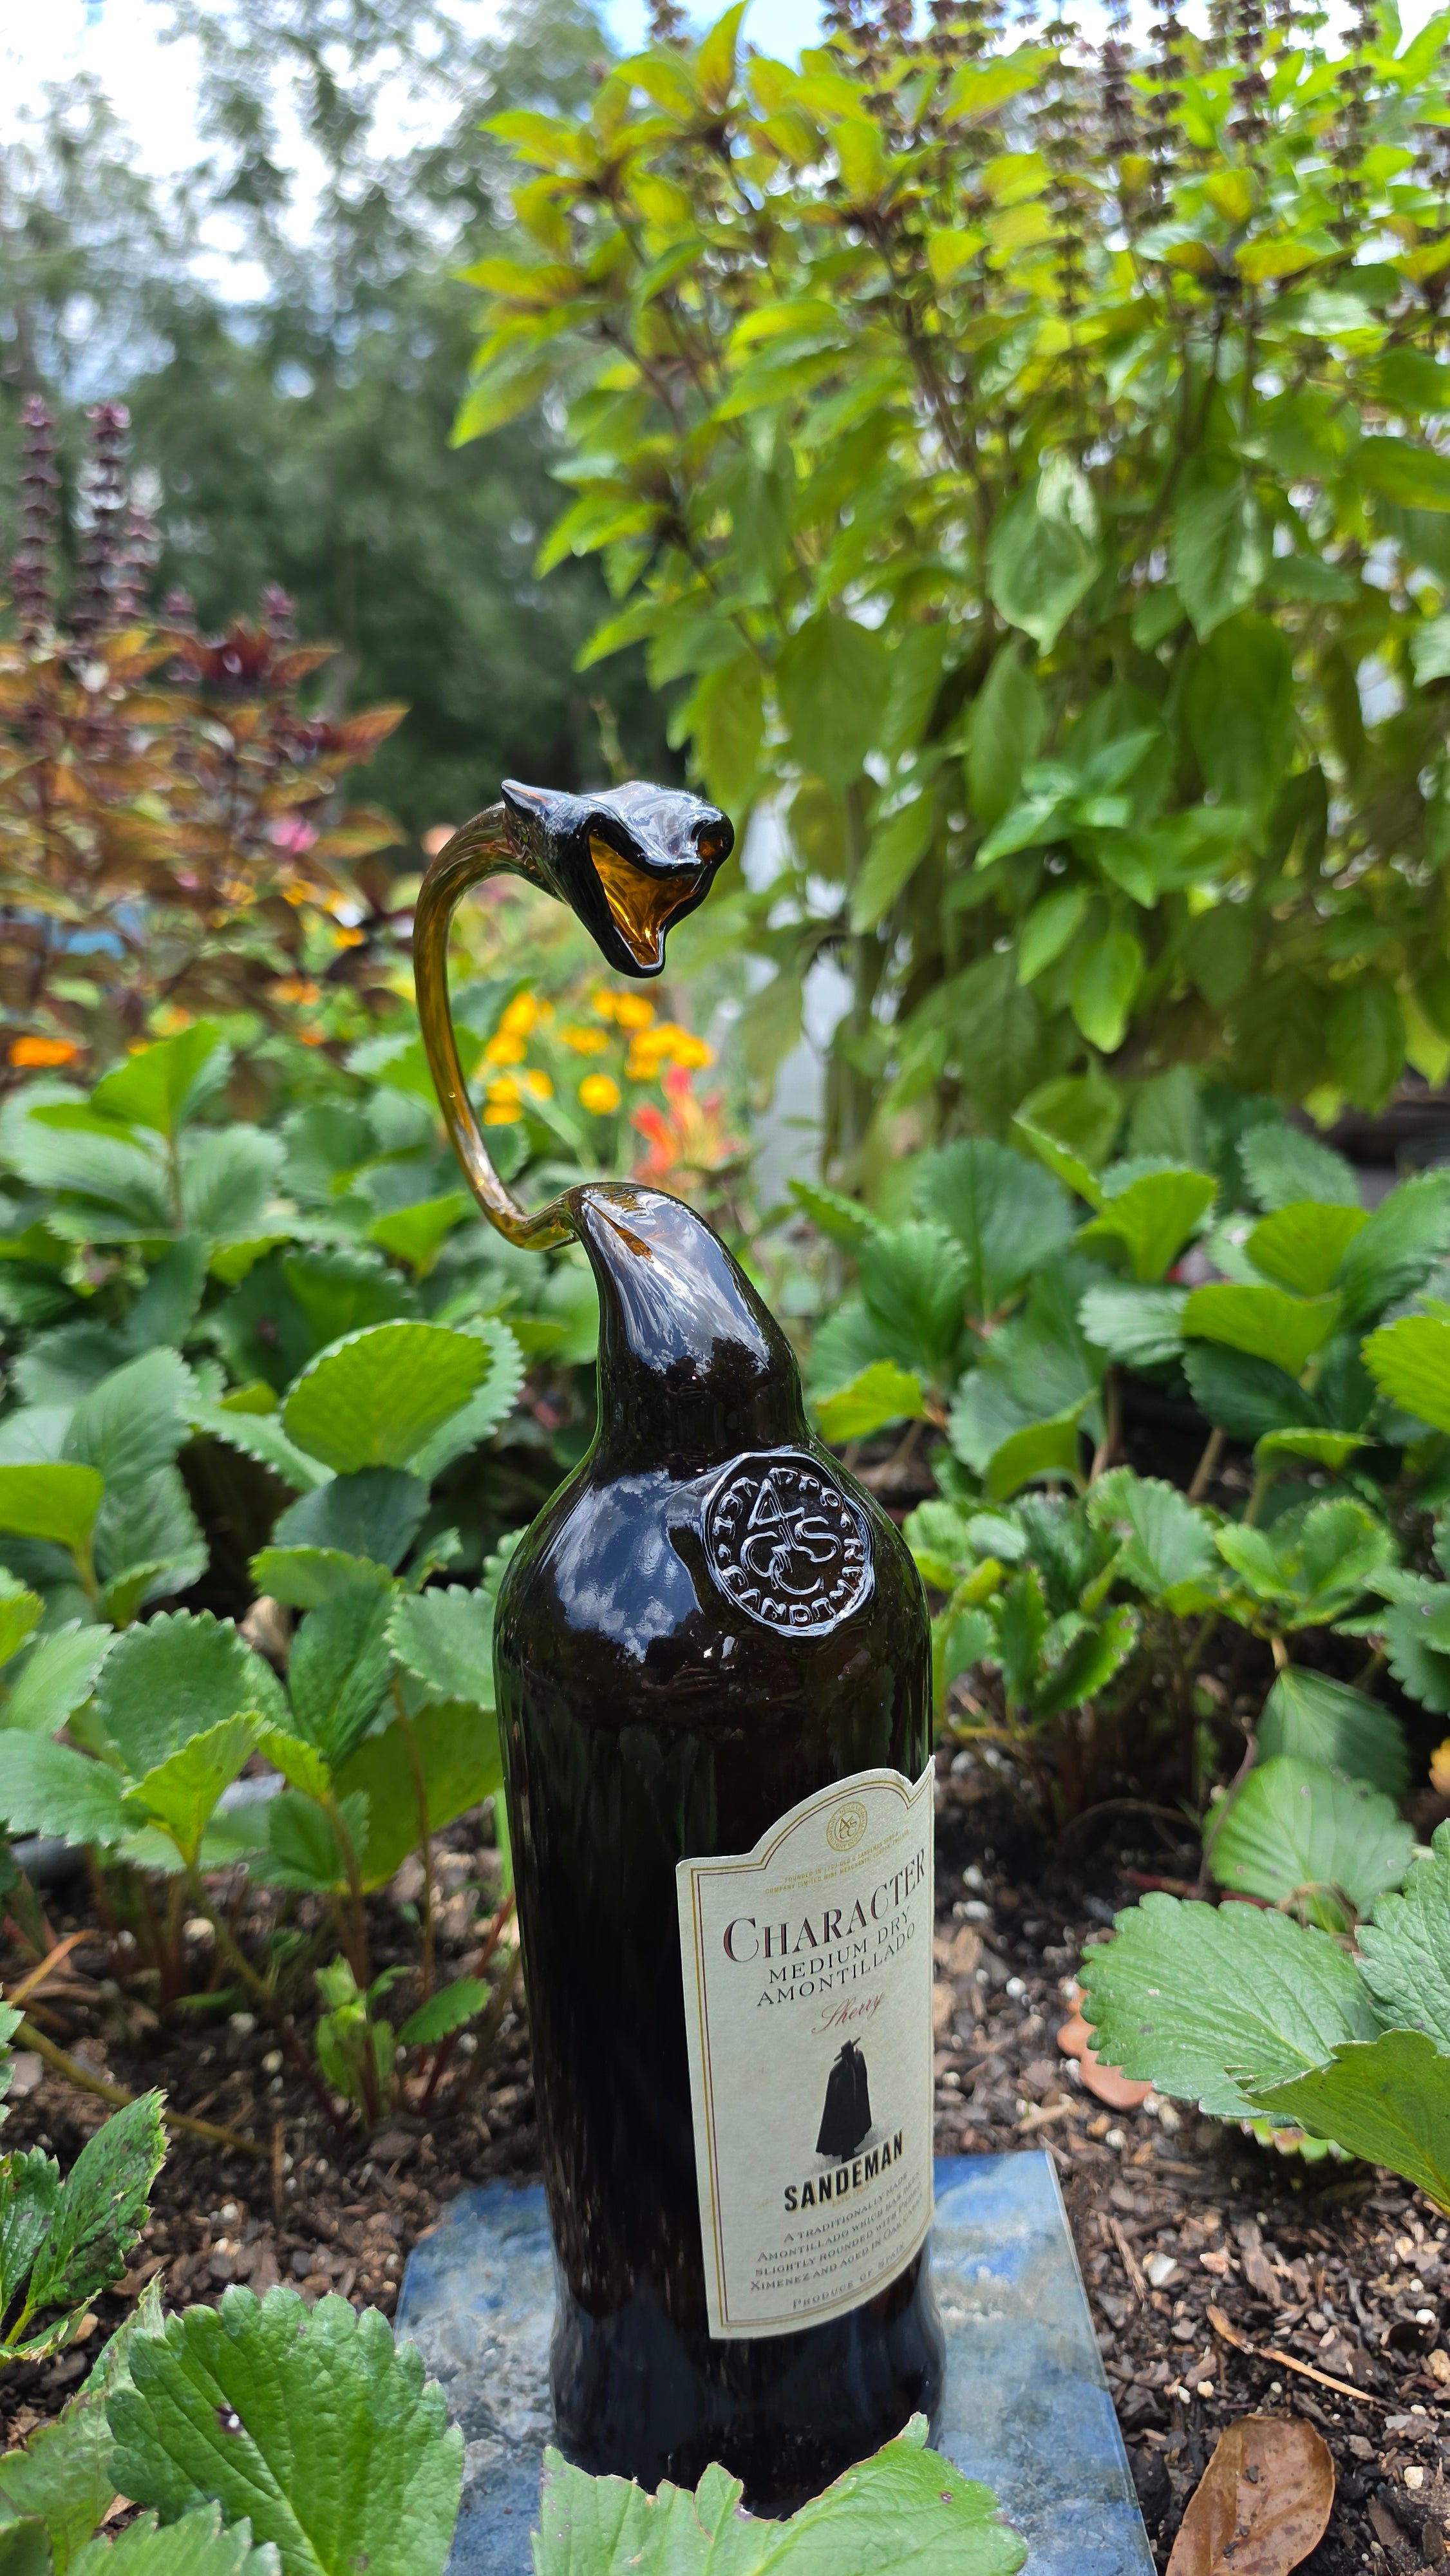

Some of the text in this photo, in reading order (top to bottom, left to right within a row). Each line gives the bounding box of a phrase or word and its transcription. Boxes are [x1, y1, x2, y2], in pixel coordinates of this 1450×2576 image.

[723, 1847, 925, 1963] CHARACTER
[765, 1884, 795, 1894] COMPANY
[798, 1877, 821, 1887] LIMITED
[757, 1922, 915, 2007] AMONTILLADO
[769, 1906, 910, 1984] MEDIUM DRY
[811, 1991, 885, 2034] Sherry
[784, 2128, 903, 2212] SANDEMAN
[757, 2230, 849, 2262] AMONTILLADO
[852, 2208, 883, 2231] WHICH
[885, 2193, 901, 2214] HAS
[784, 2171, 907, 2243] A TRADITIONALLY MADE
[750, 2273, 810, 2291] XIMENEZ
[813, 2262, 837, 2278] AND
[840, 2247, 869, 2268] AGED
[871, 2239, 881, 2250] IN
[883, 2221, 901, 2240] OAK
[755, 2256, 816, 2277] SLIGHTLY
[819, 2230, 873, 2262] ROUNDED
[876, 2212, 897, 2232] WITH
[793, 2241, 905, 2309] PRODUCE OF SPAIN
